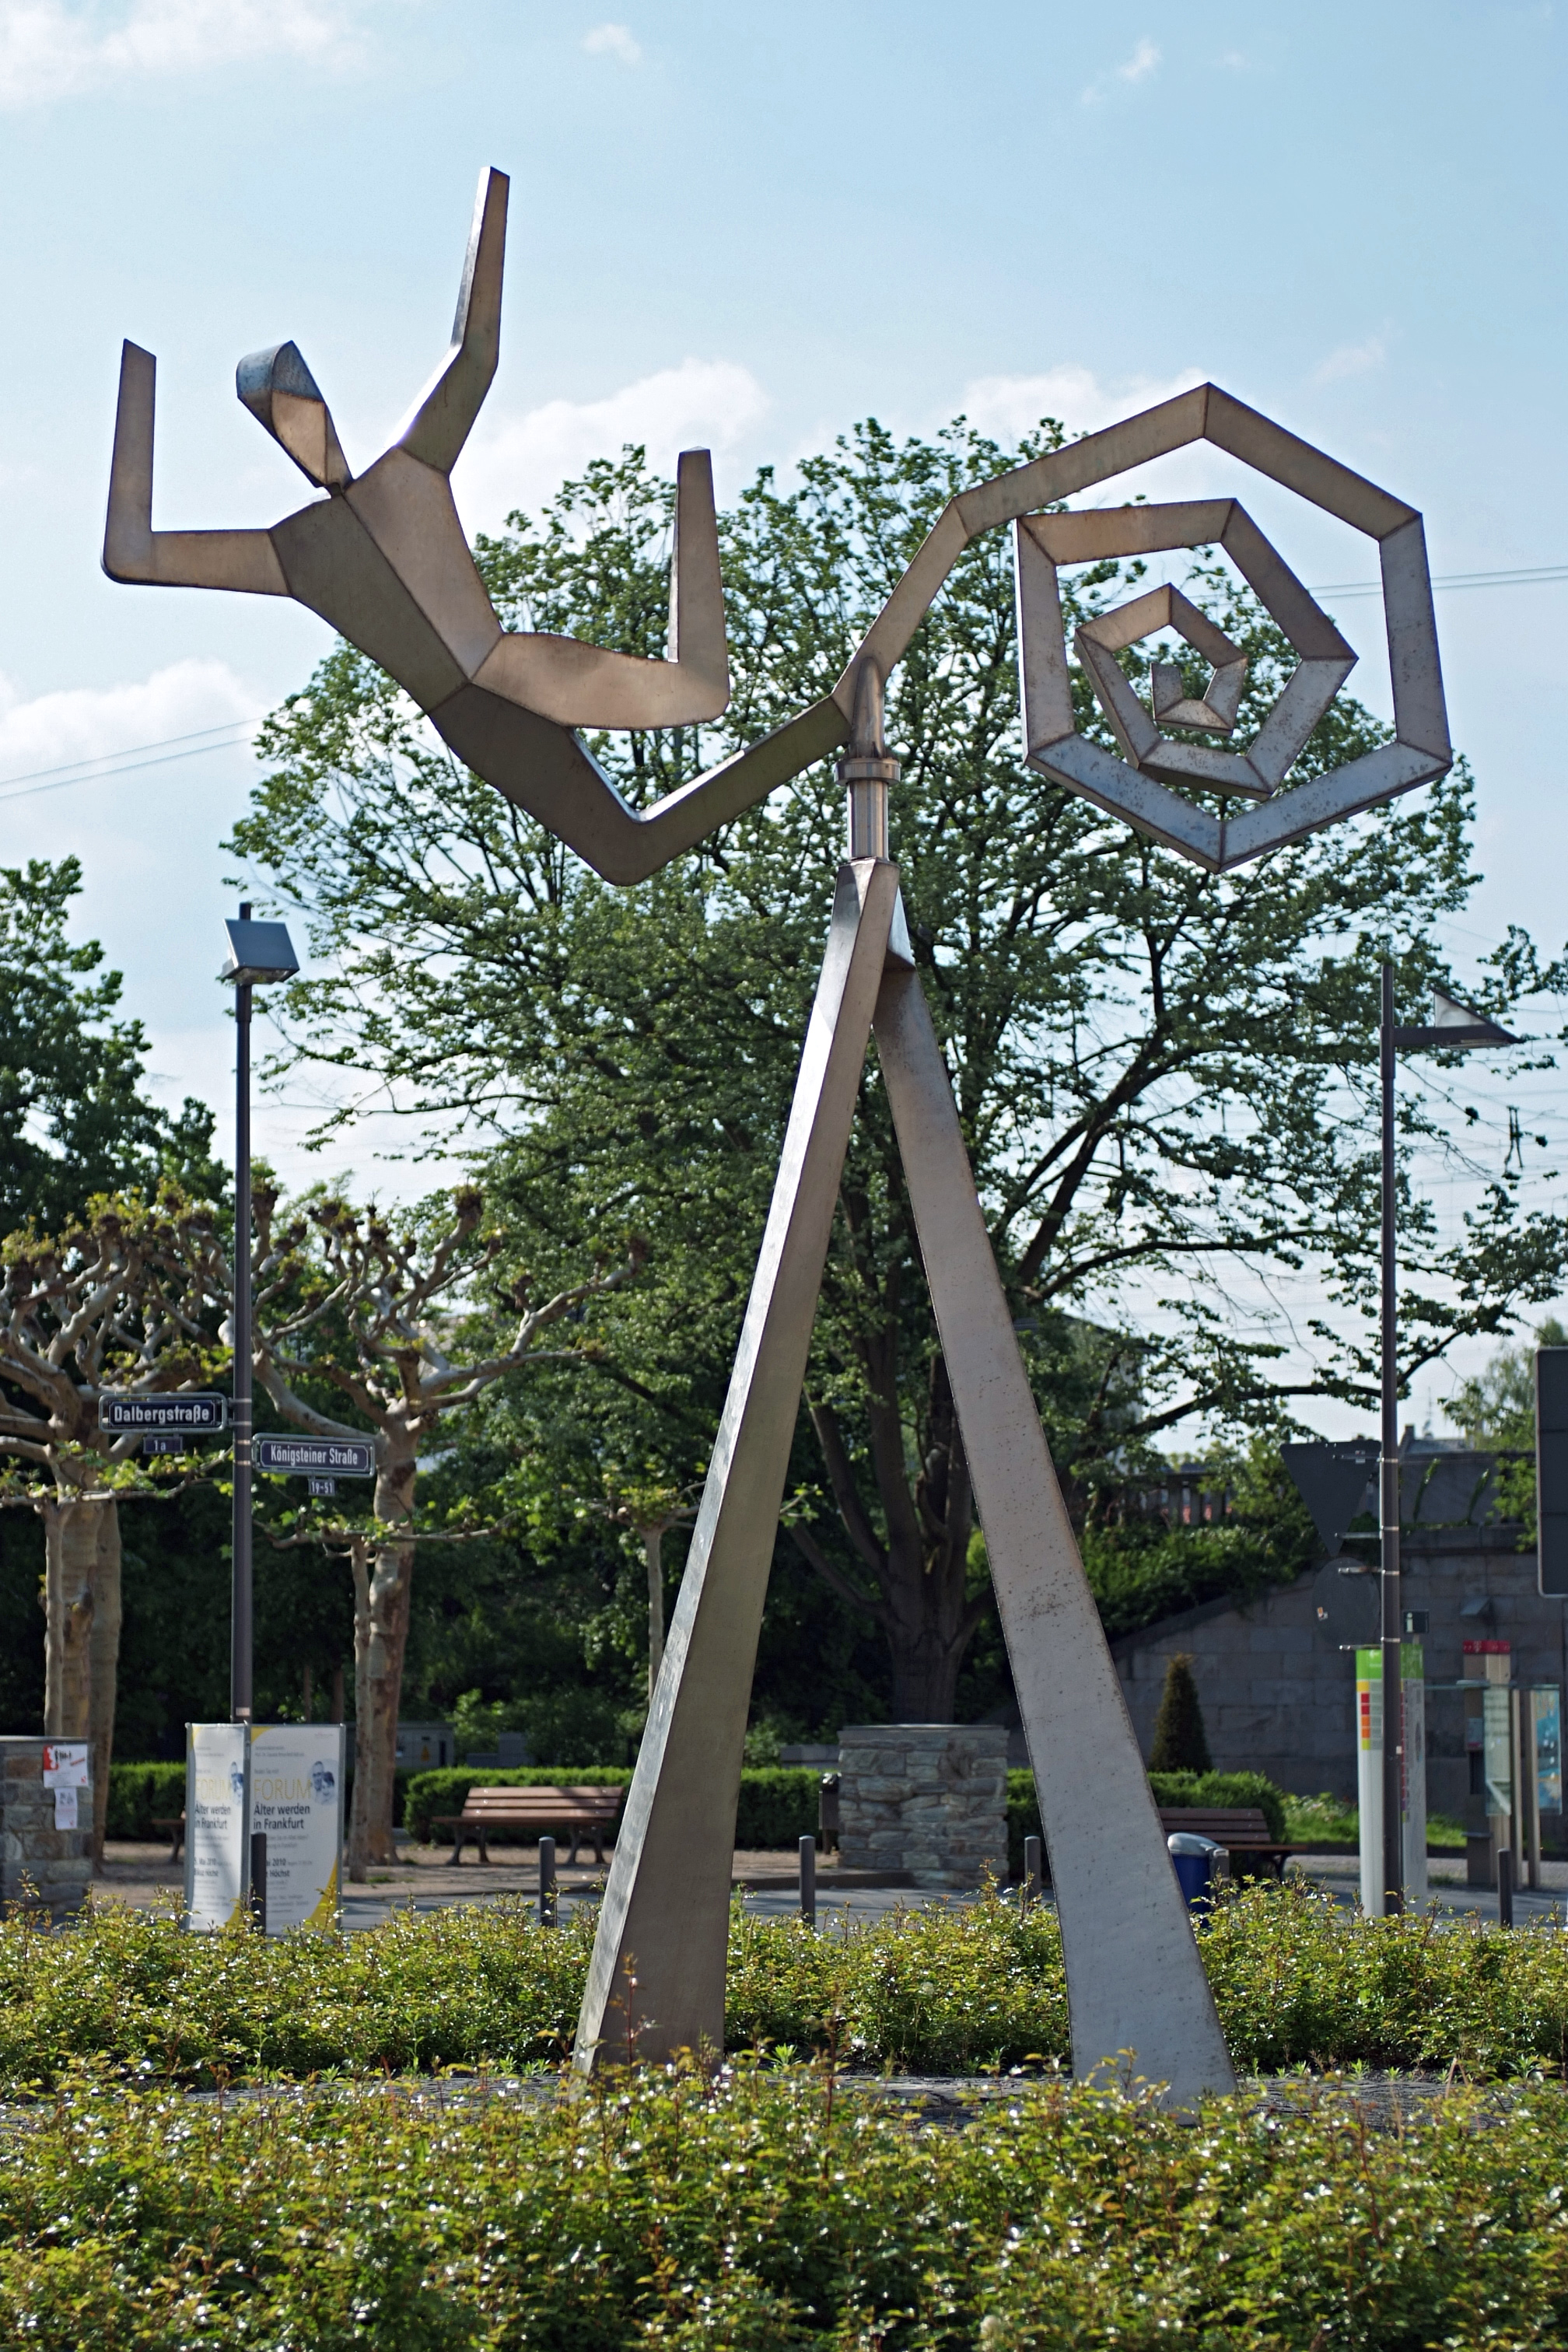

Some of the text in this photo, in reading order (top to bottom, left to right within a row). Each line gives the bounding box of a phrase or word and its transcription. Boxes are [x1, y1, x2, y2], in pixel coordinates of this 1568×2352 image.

[114, 1405, 209, 1425] Dalbergstraße
[271, 1444, 358, 1467] Königsteiner Straße
[312, 1481, 333, 1494] 19-51
[254, 1779, 311, 1801] FORUM
[210, 1803, 231, 1815] werden
[254, 1802, 310, 1815] Älter werden
[201, 1818, 227, 1829] Frankfurt
[254, 1818, 304, 1829] in Frankfurt
[272, 1857, 286, 1867] 2010
